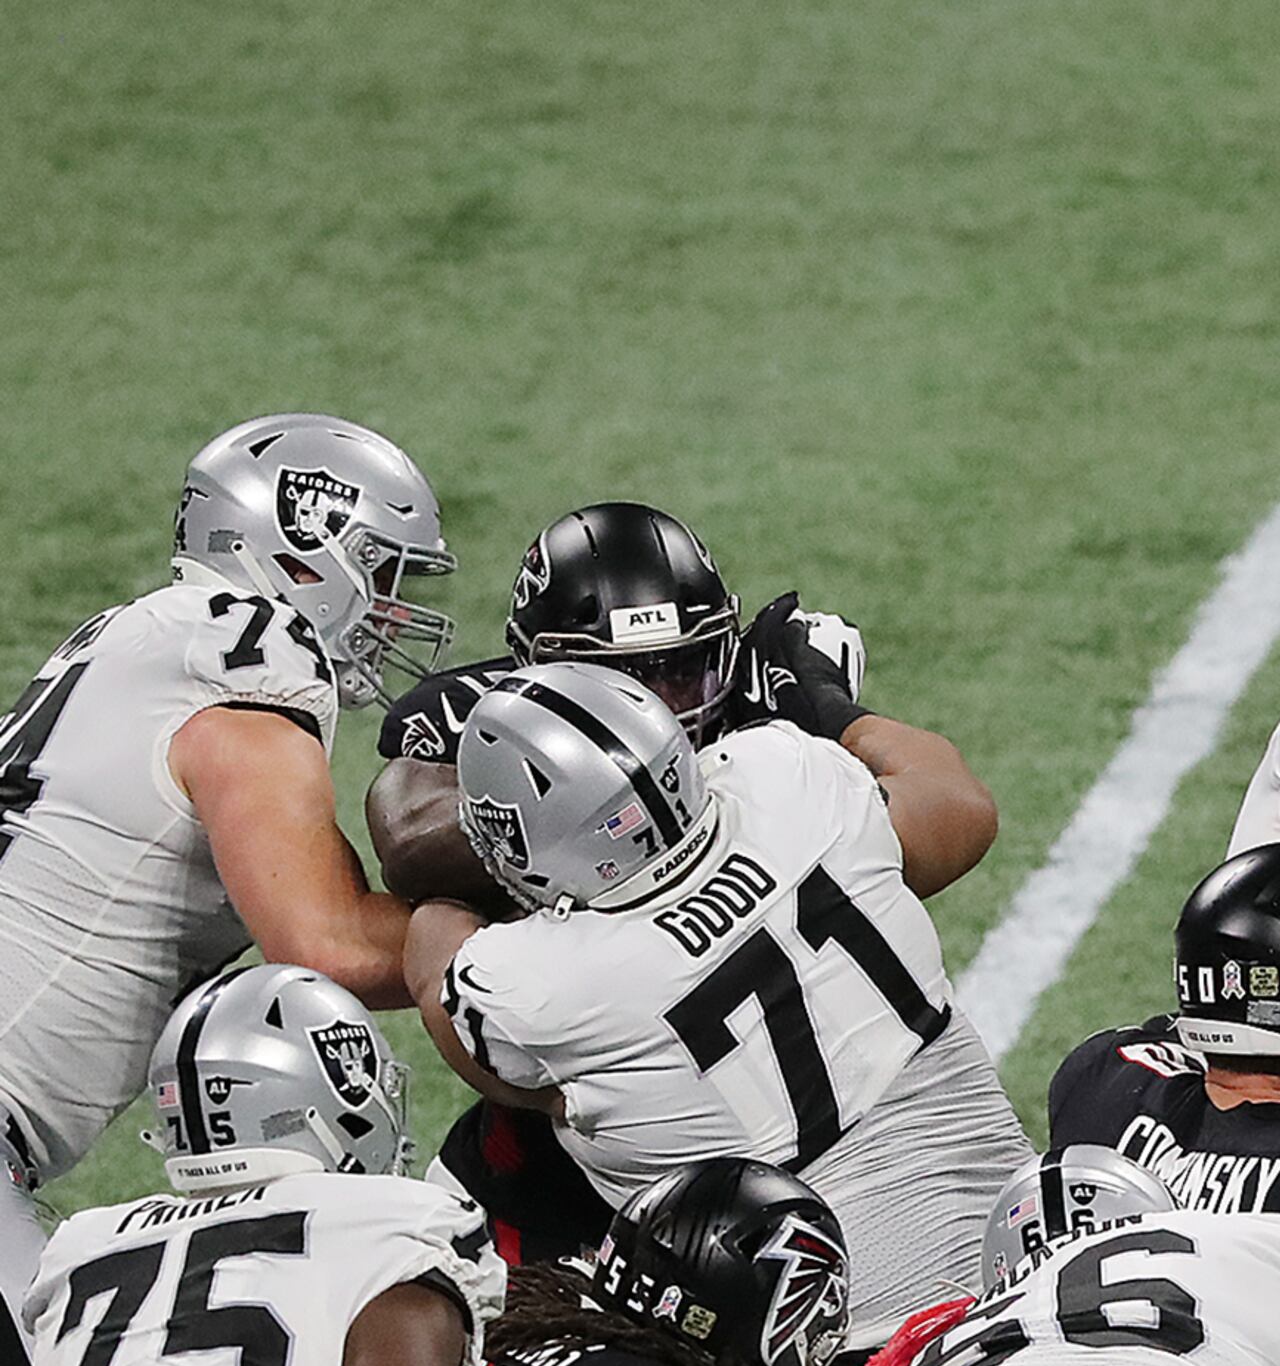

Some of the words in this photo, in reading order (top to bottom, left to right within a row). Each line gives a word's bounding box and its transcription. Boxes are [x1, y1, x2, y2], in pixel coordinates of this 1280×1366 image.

[287, 473, 352, 497] RAIDERS
[629, 610, 667, 627] ATL
[652, 825, 709, 883] RAIDERS
[655, 852, 777, 958] GOOD
[1178, 965, 1216, 1004] 50
[657, 862, 952, 1173] 71
[209, 1082, 228, 1095] AL
[220, 1163, 232, 1174] OF
[234, 1161, 248, 1172] US
[1073, 1186, 1093, 1198] AL
